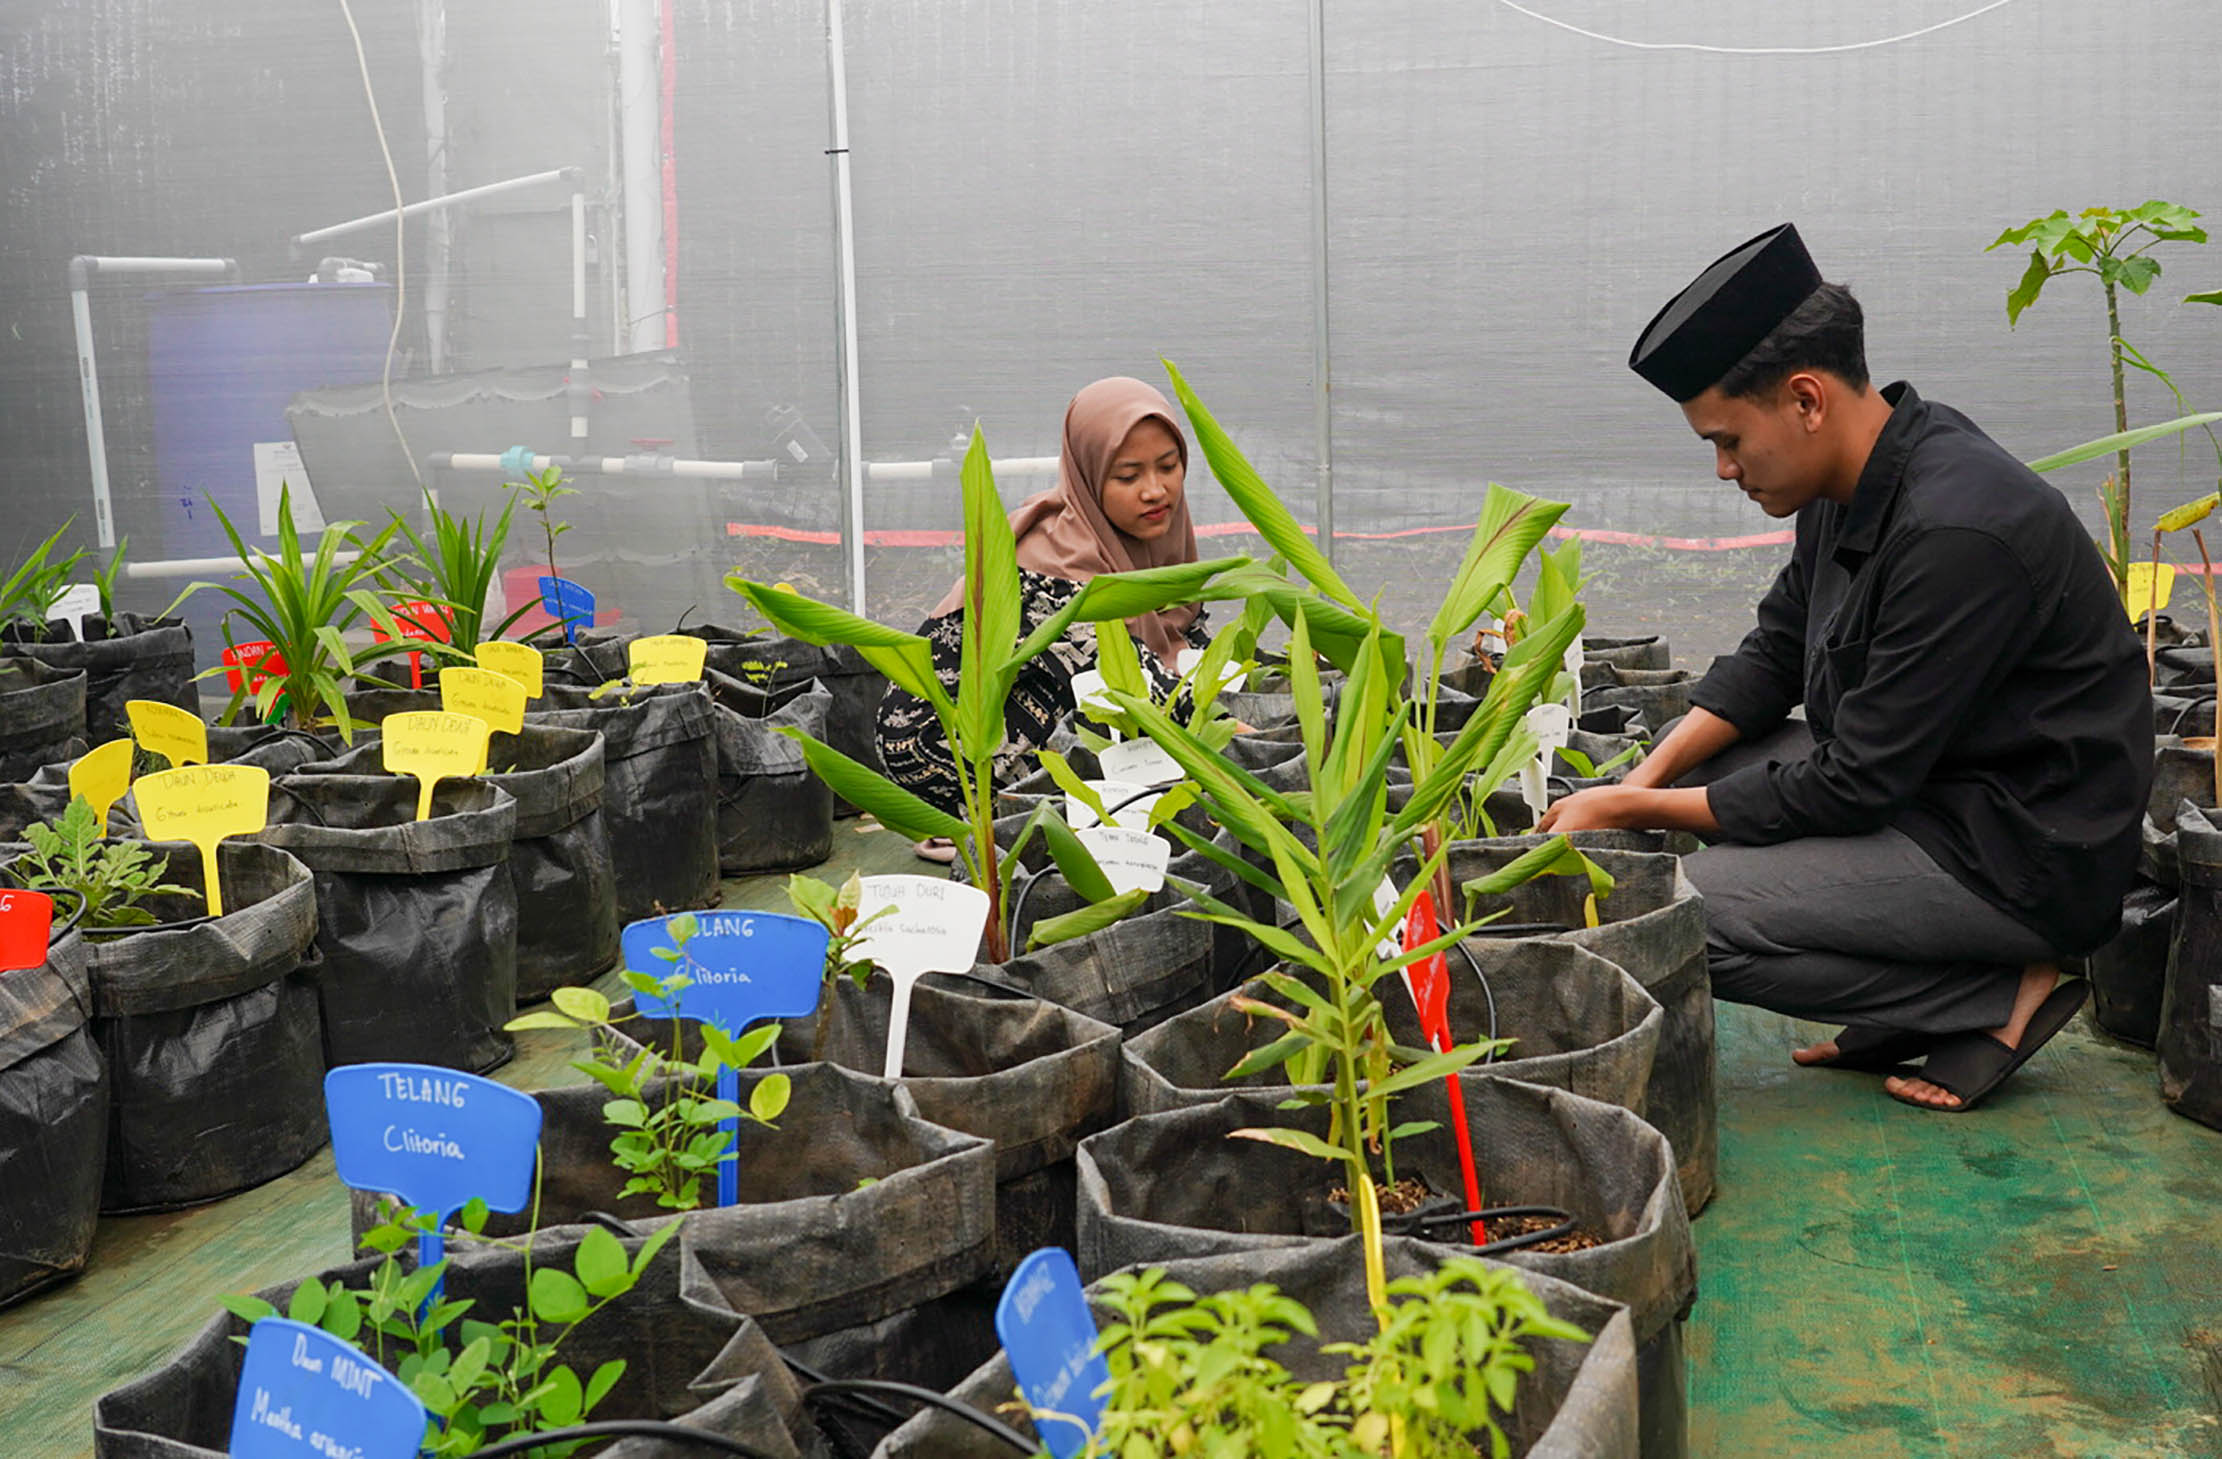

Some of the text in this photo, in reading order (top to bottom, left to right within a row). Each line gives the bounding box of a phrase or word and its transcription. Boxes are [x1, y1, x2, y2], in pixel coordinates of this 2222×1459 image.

[693, 917, 755, 938] LANG
[377, 1072, 470, 1109] TELANG
[383, 1124, 465, 1160] Clitoria
[330, 1355, 384, 1400] MINT
